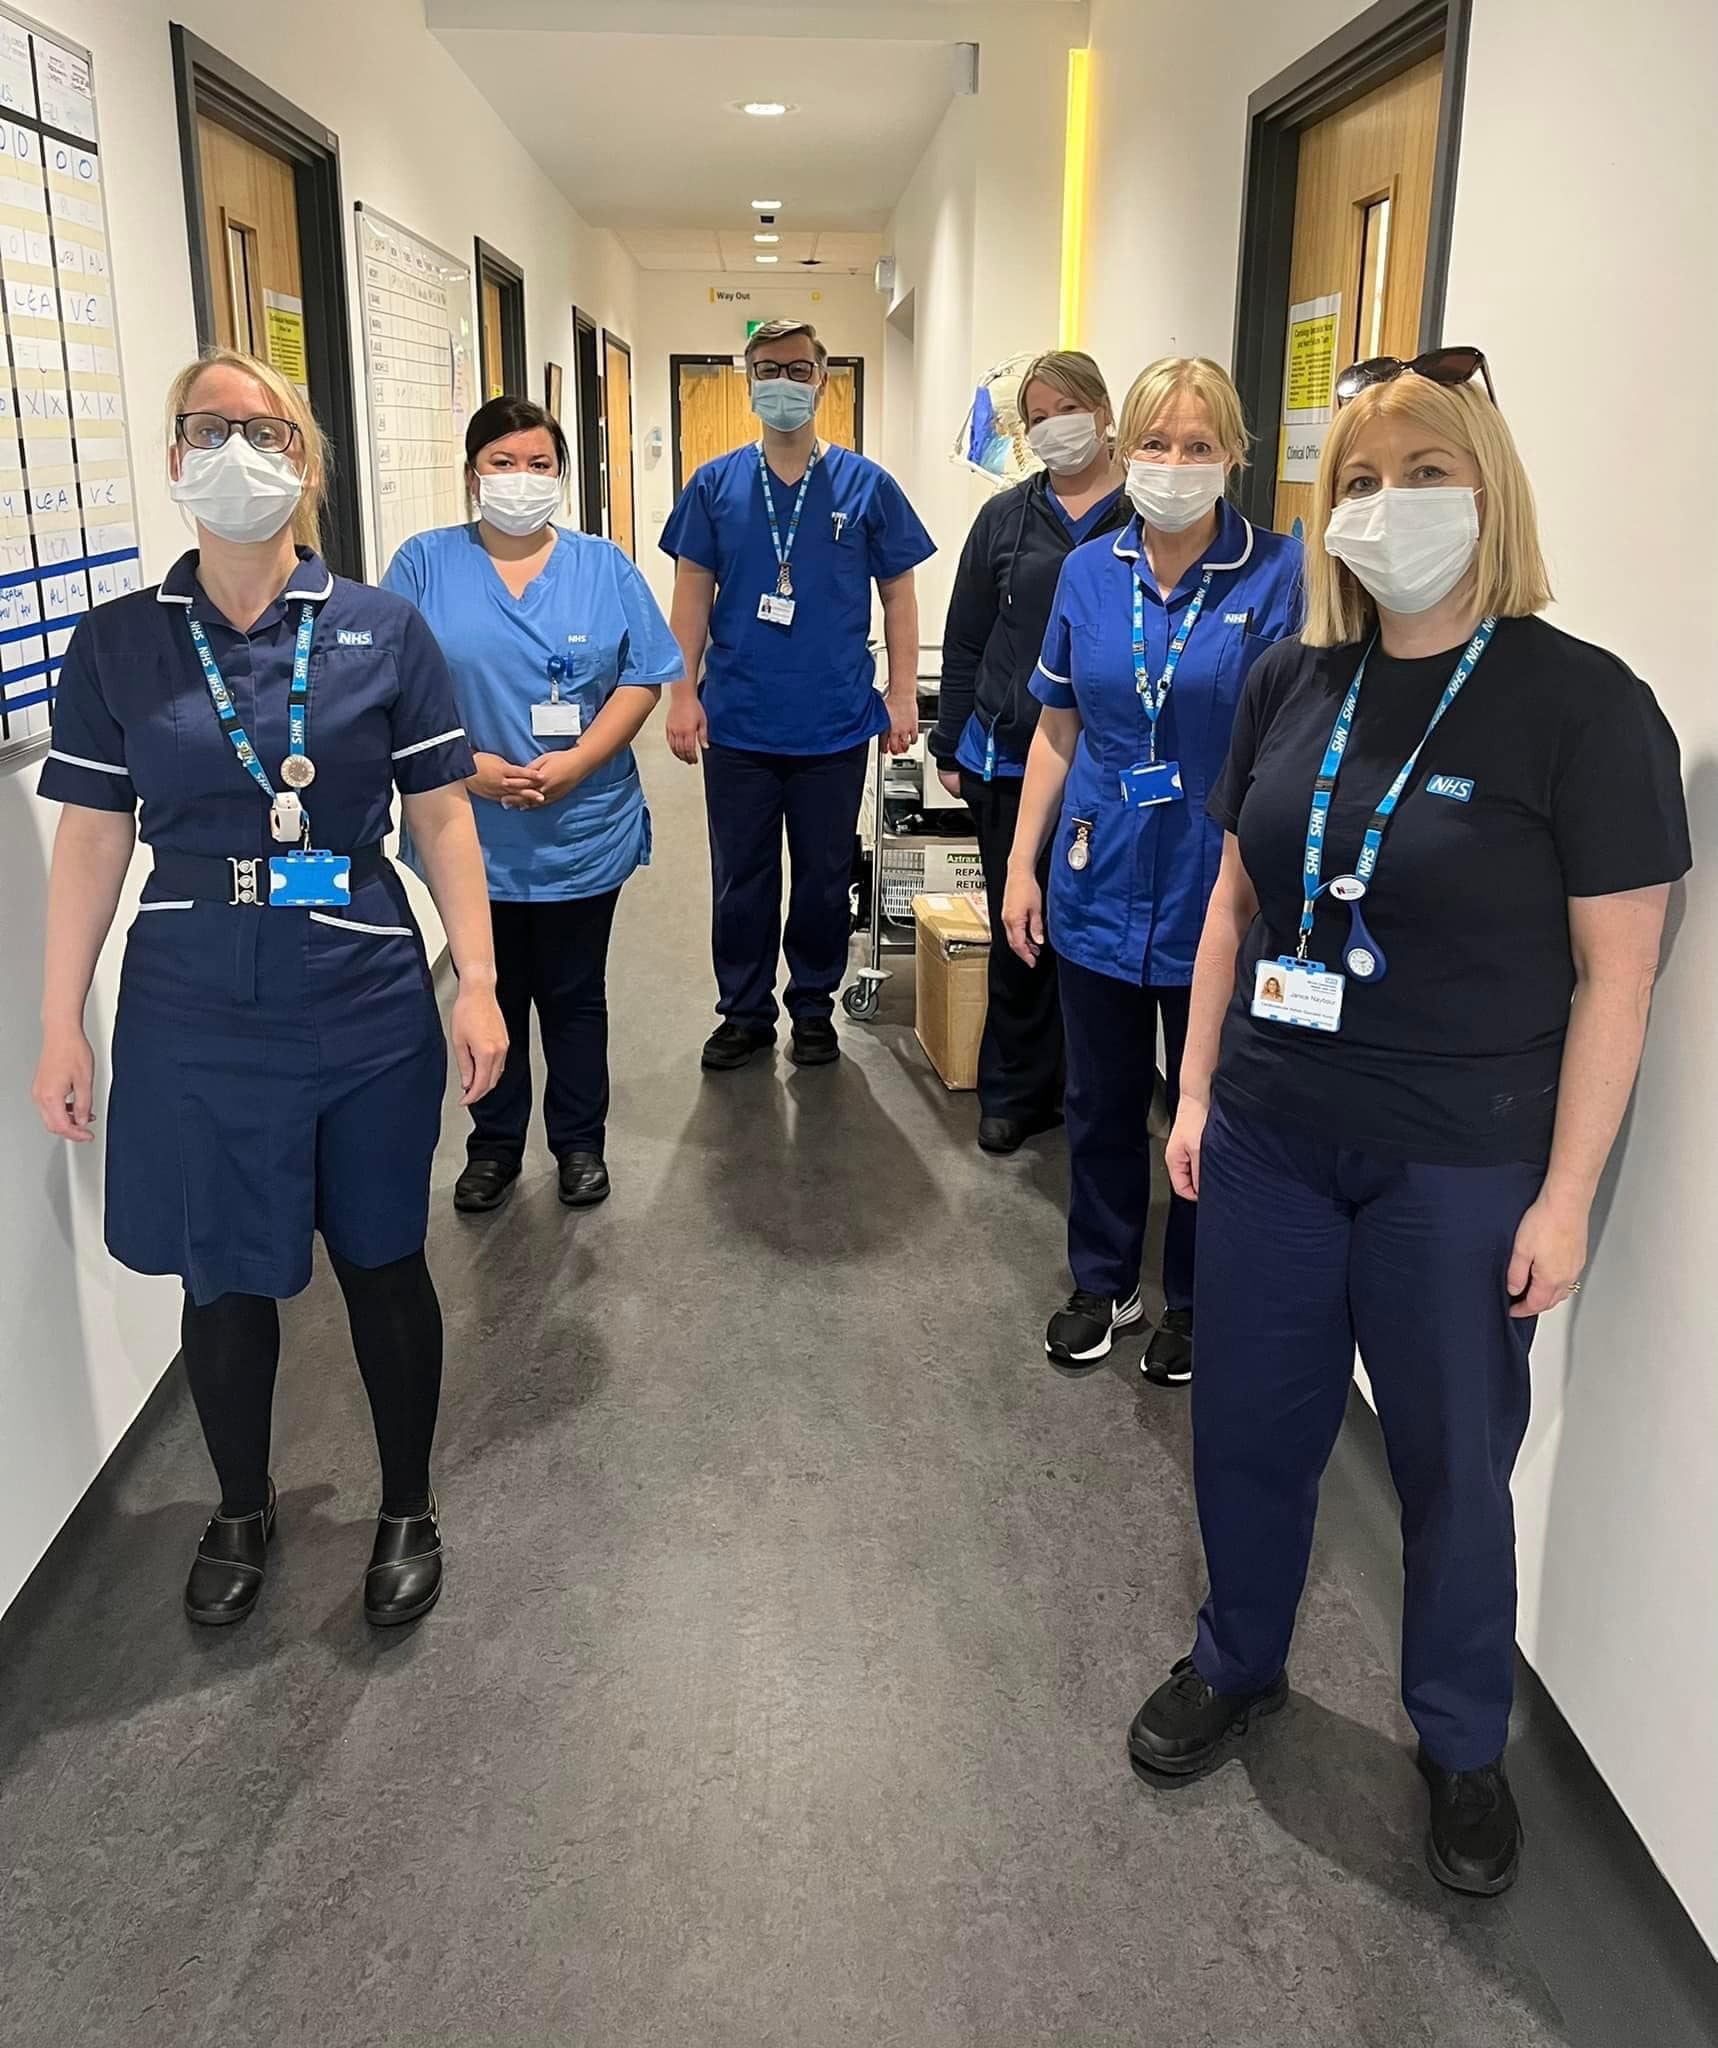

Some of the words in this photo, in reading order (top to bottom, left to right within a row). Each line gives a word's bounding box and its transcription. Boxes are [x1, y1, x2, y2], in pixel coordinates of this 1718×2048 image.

[716, 291, 733, 302] Way
[736, 291, 750, 300] Out
[1287, 445, 1304, 460] Clinical
[1482, 614, 1497, 632] NH
[190, 620, 205, 641] NHS
[198, 646, 213, 667] NHS
[340, 632, 370, 645] NHS
[567, 635, 587, 643] NHS
[1465, 636, 1484, 664] NHS
[296, 657, 306, 679] NHS
[1448, 667, 1466, 696] NHS
[1342, 694, 1356, 722] NHS
[291, 719, 302, 745] NHS
[1331, 726, 1348, 753] NHS
[1430, 776, 1470, 797] NHS
[1310, 807, 1325, 837] NHS
[1306, 846, 1320, 875] NHS
[1358, 847, 1376, 877] NHS
